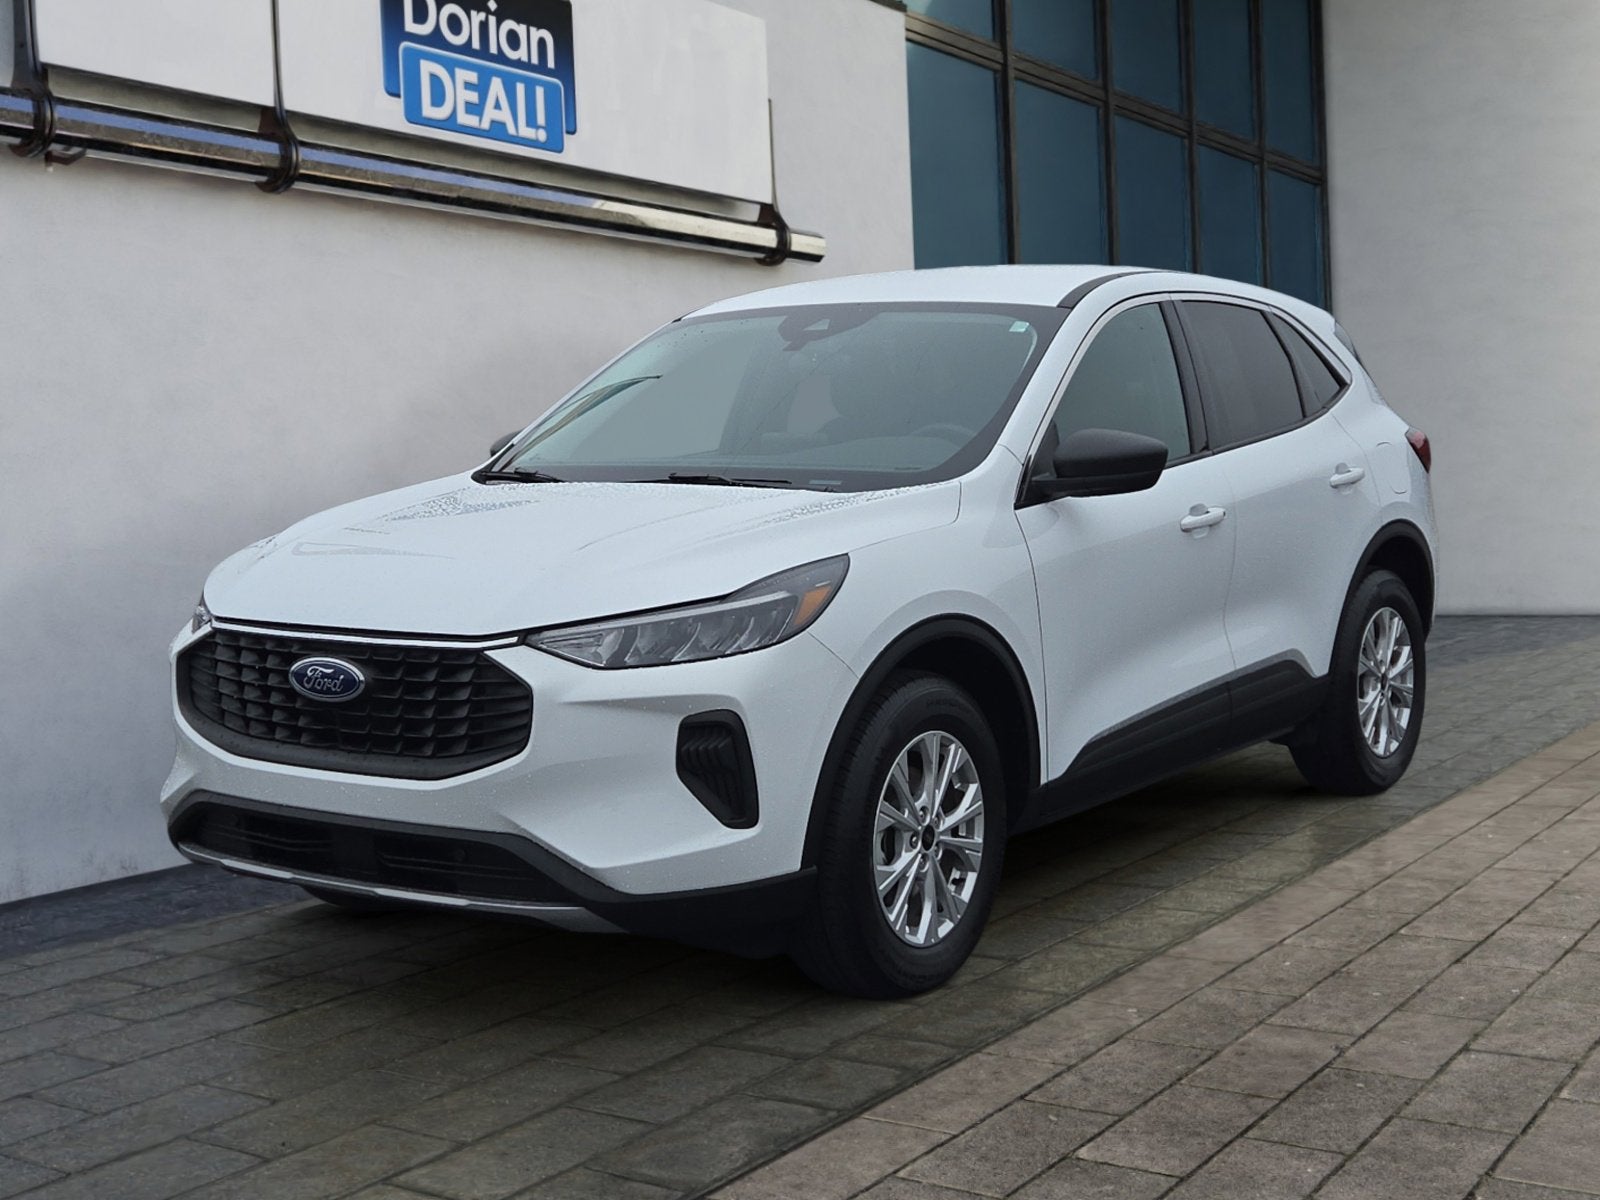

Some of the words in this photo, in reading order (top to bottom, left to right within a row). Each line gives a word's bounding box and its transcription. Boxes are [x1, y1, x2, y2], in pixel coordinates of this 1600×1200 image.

[403, 0, 555, 69] Dorian
[419, 58, 548, 143] DEAL!
[303, 665, 345, 692] Ford
